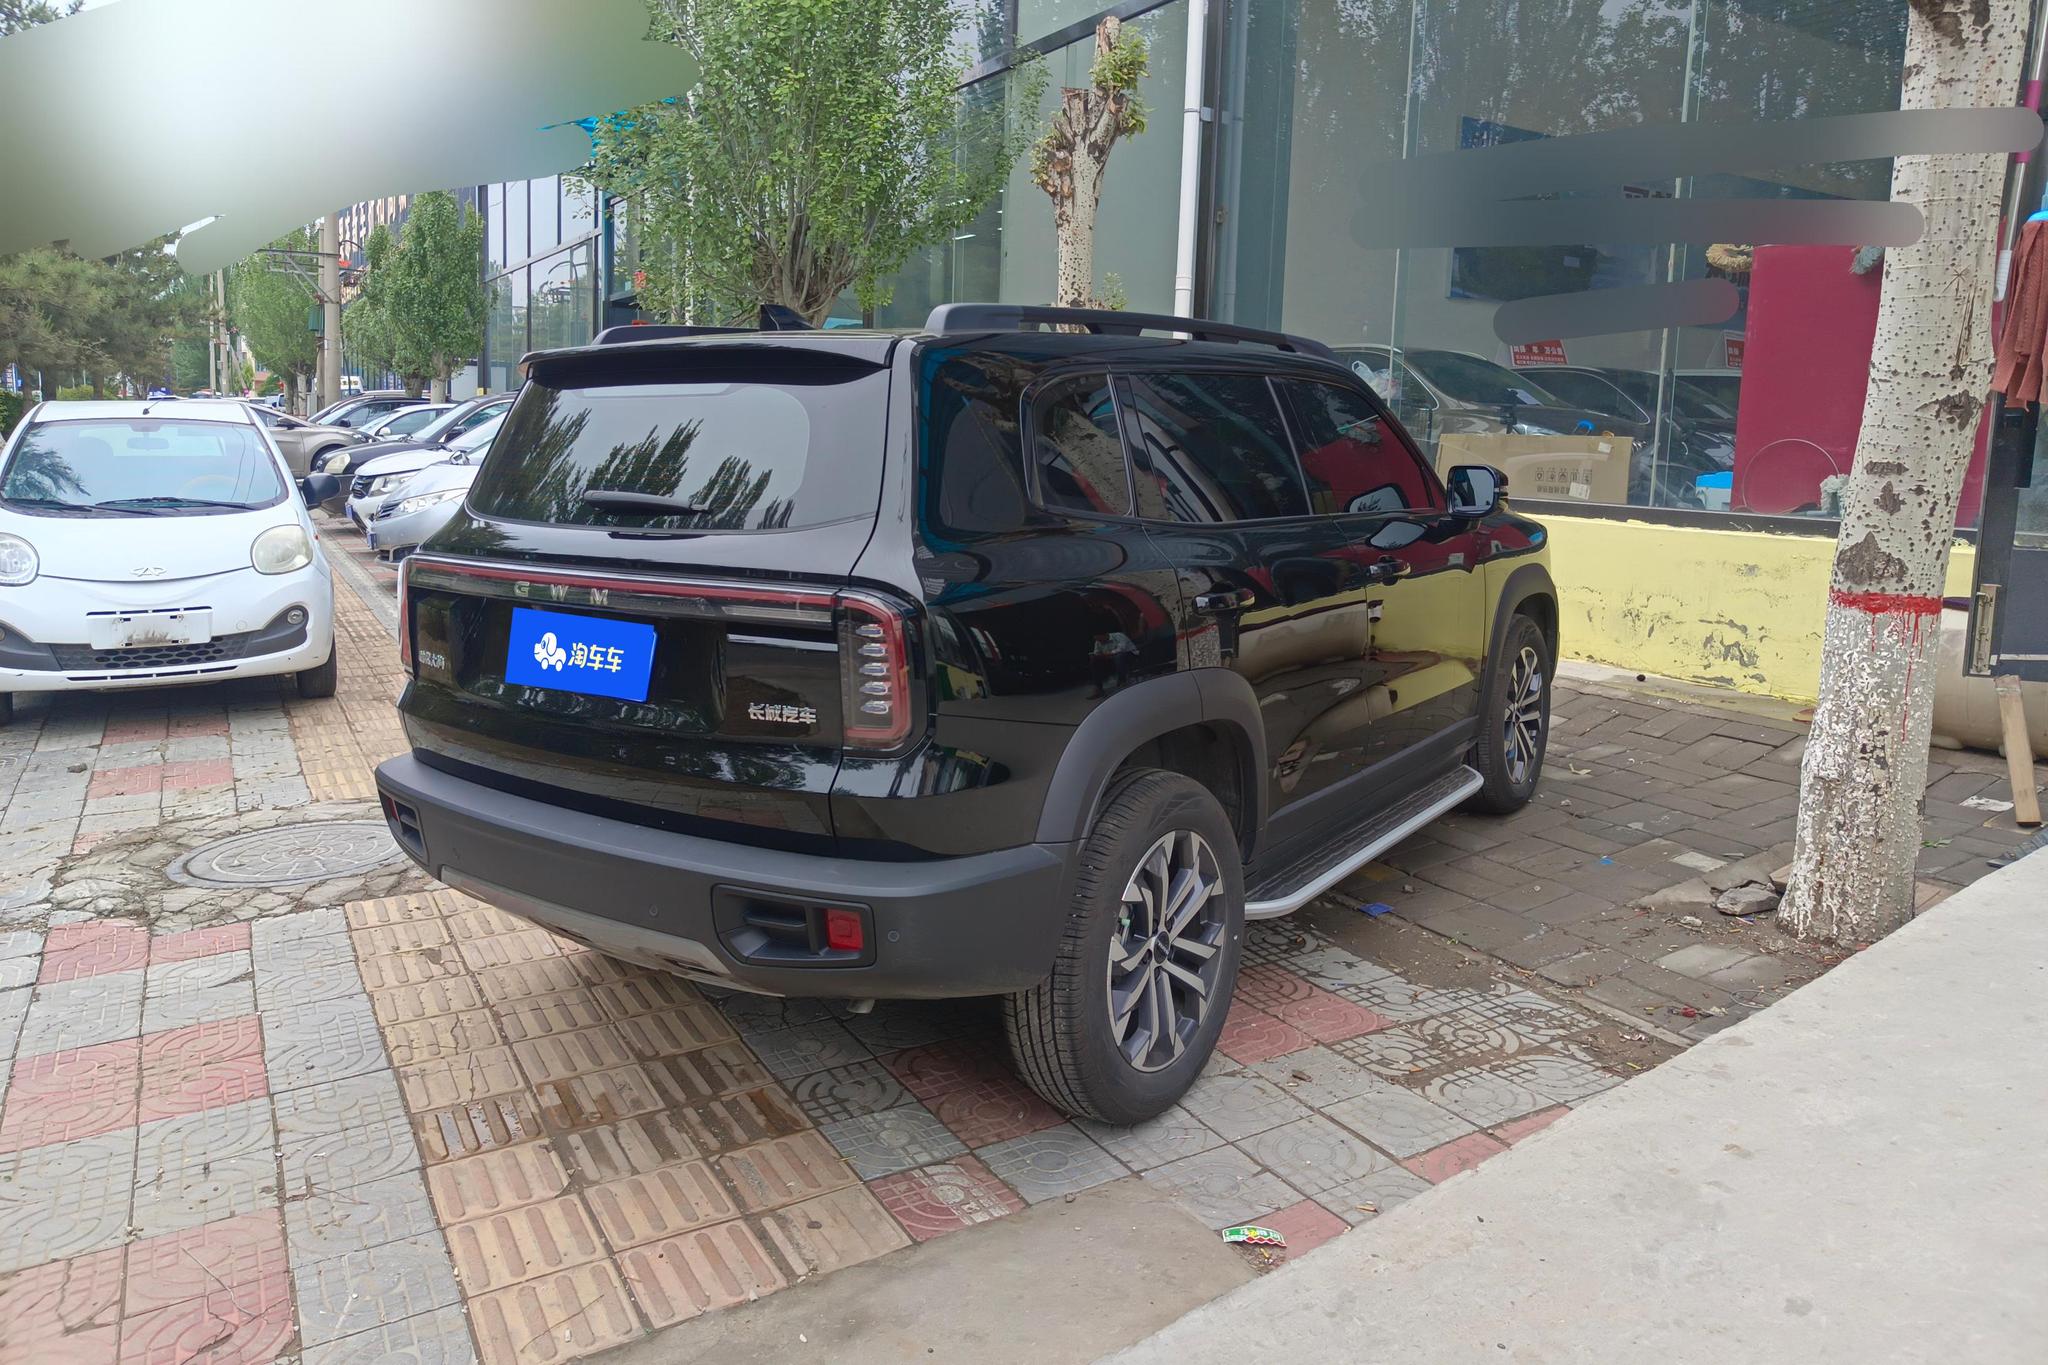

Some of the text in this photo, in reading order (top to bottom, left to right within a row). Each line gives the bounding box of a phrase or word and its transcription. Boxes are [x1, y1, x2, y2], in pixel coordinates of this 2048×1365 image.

[513, 581, 609, 606] GWM
[748, 702, 817, 724] 长城汽车
